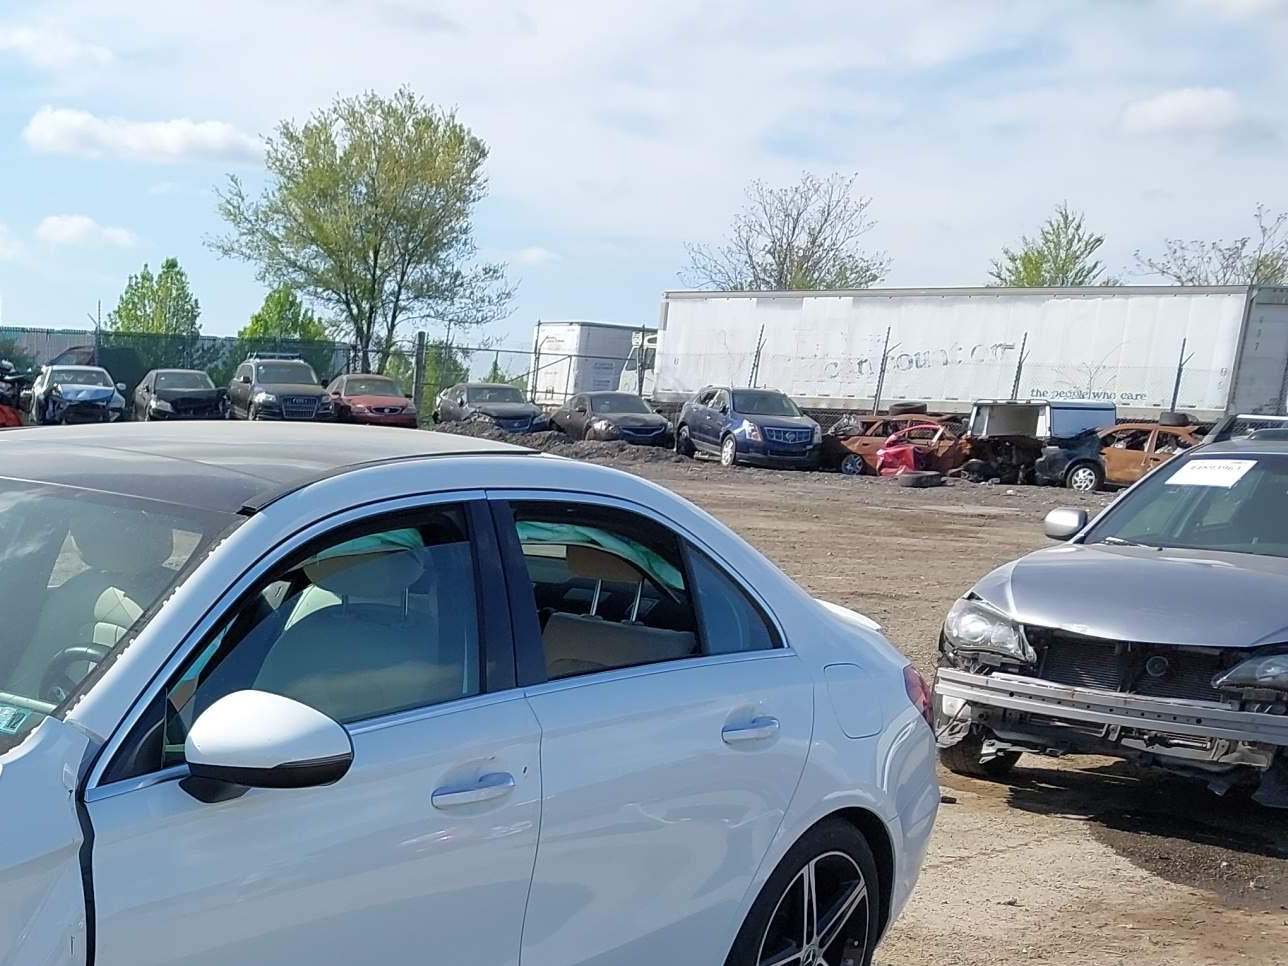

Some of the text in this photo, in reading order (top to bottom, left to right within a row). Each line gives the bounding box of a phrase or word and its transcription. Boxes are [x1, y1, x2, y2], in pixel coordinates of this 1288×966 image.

[1031, 388, 1048, 398] the
[1092, 389, 1116, 400] who
[1120, 391, 1147, 400] care
